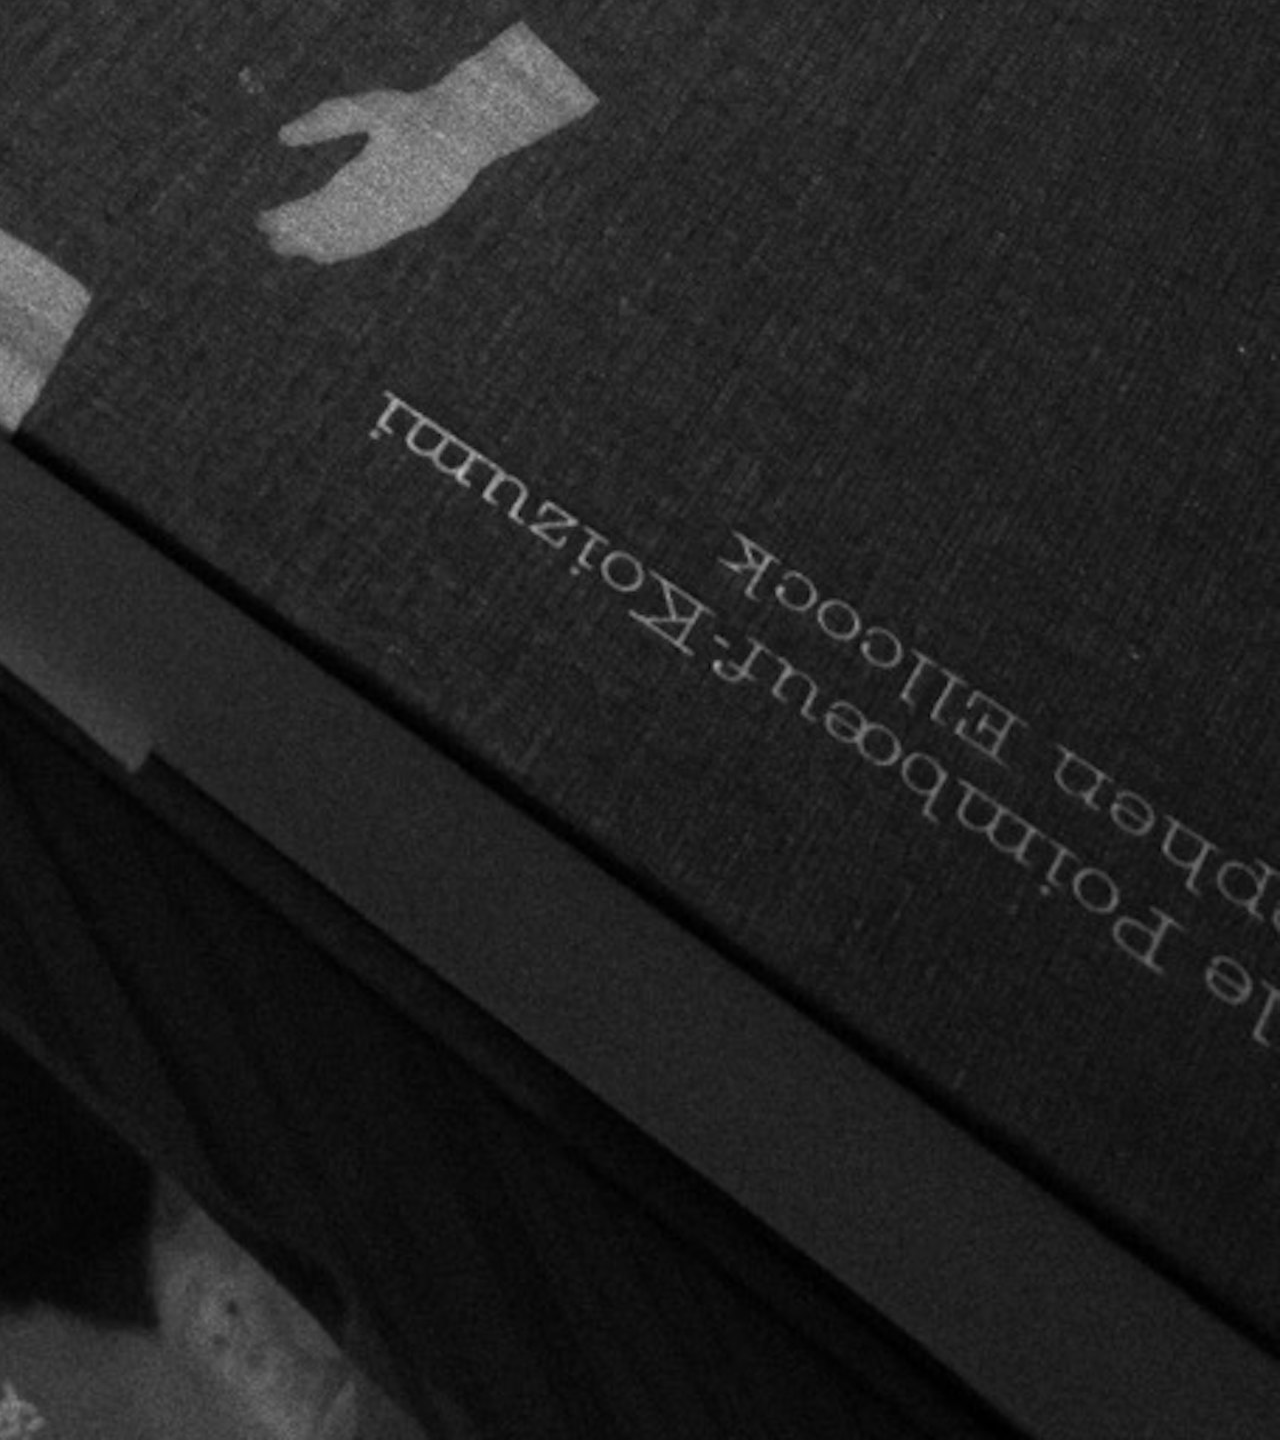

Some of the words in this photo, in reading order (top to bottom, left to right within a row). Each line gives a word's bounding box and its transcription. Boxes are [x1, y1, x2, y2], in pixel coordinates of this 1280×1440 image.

[367, 389, 1188, 975] Poimbœuf-Koizumi
[717, 531, 1029, 767] Ellcock
[1051, 743, 1280, 937] phen
